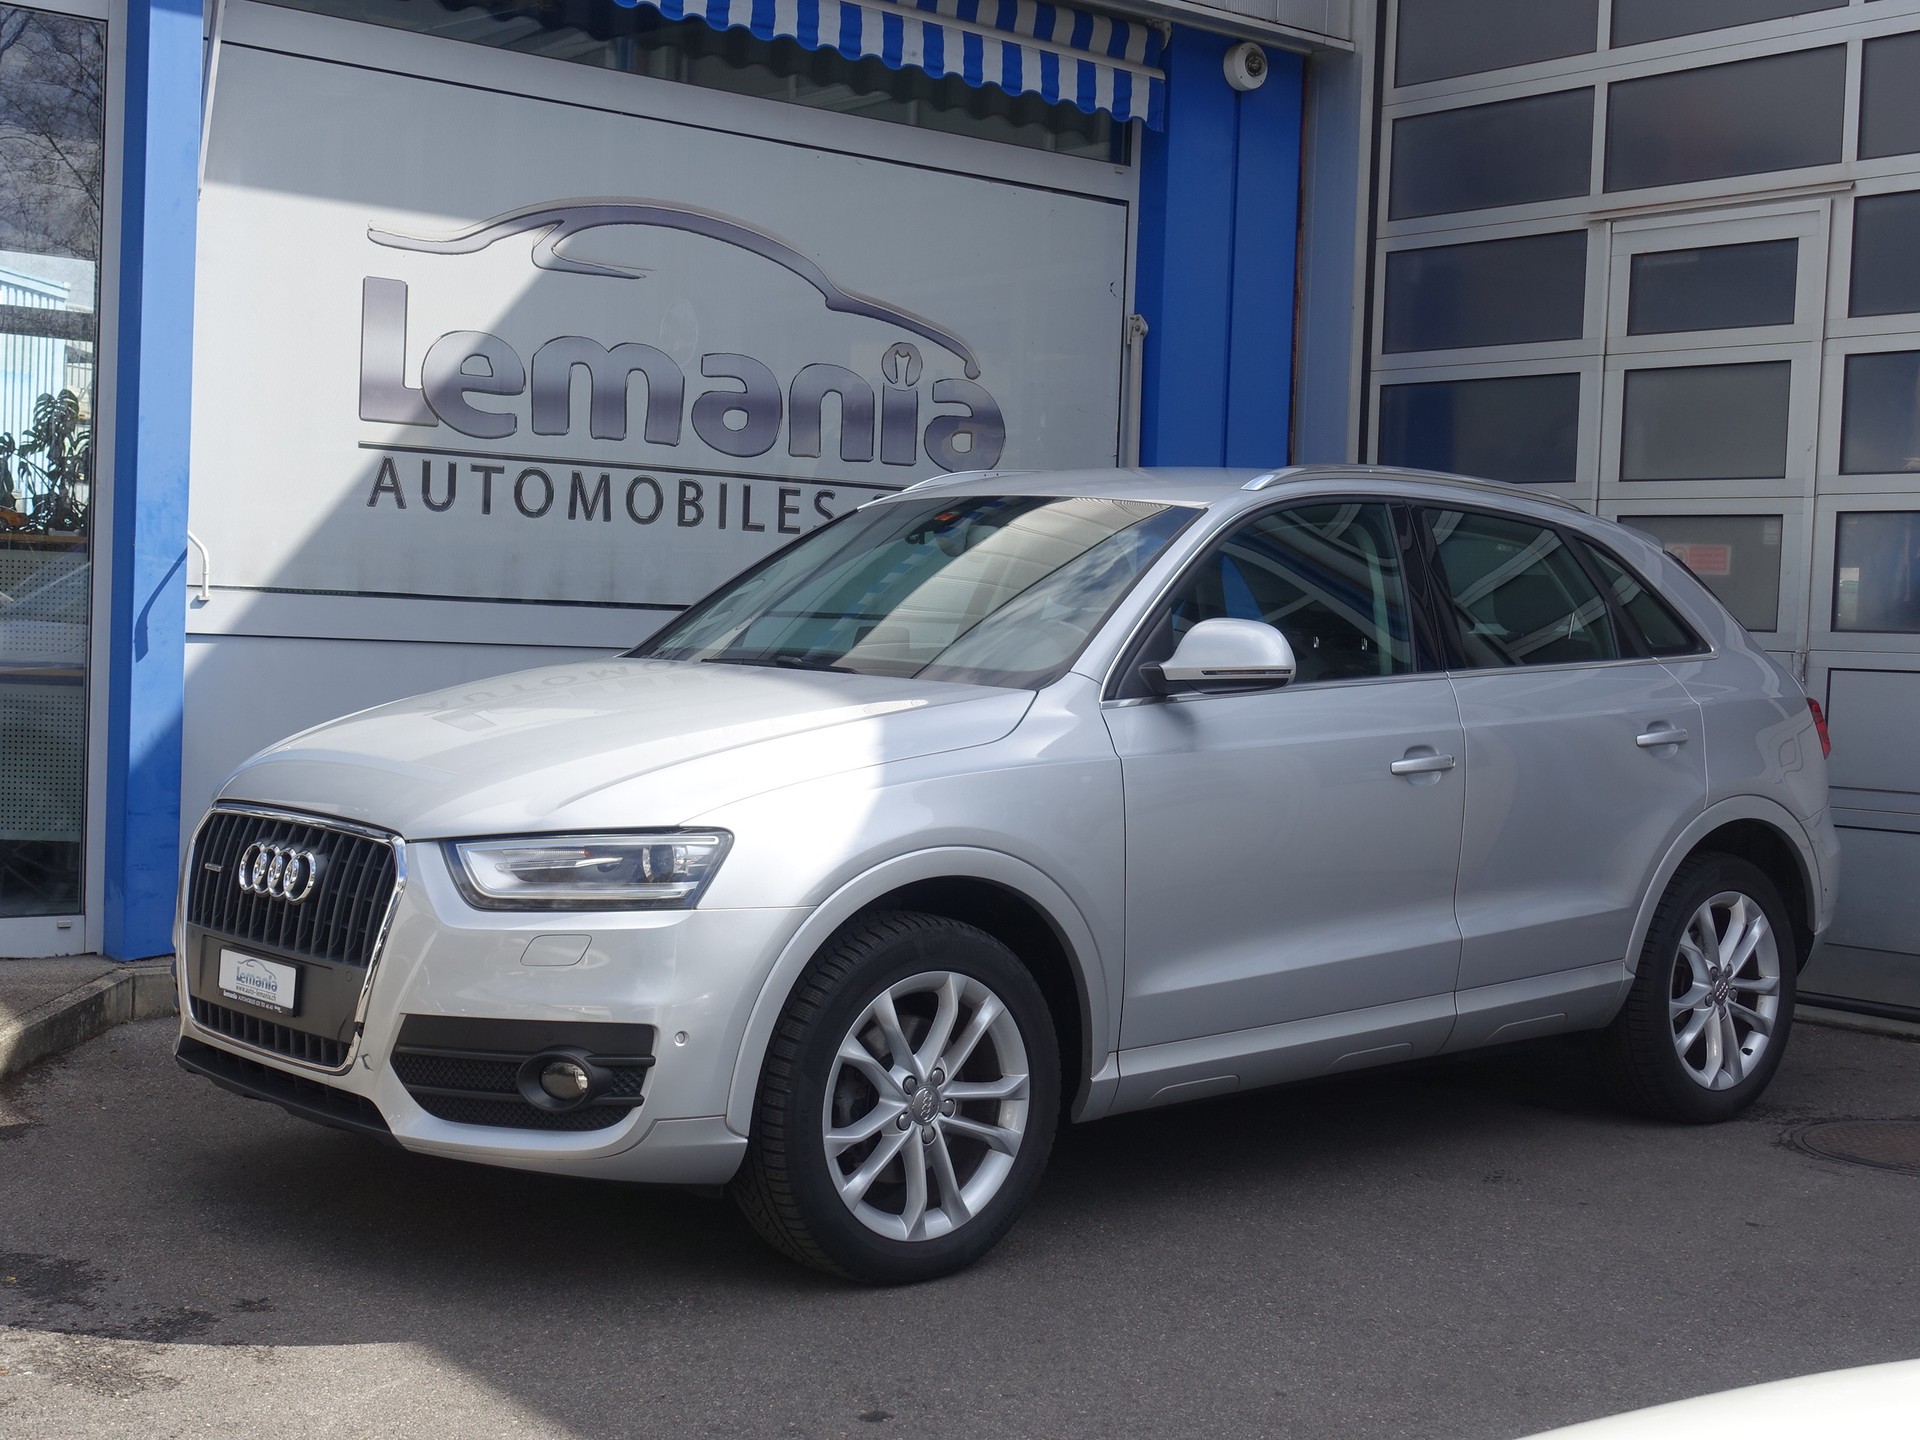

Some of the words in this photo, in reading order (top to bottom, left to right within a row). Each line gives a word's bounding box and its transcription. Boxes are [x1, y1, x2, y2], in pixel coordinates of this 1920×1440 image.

[359, 275, 1006, 473] Lemania
[366, 455, 836, 535] AUTOMOBILES
[235, 966, 278, 993] Lemania
